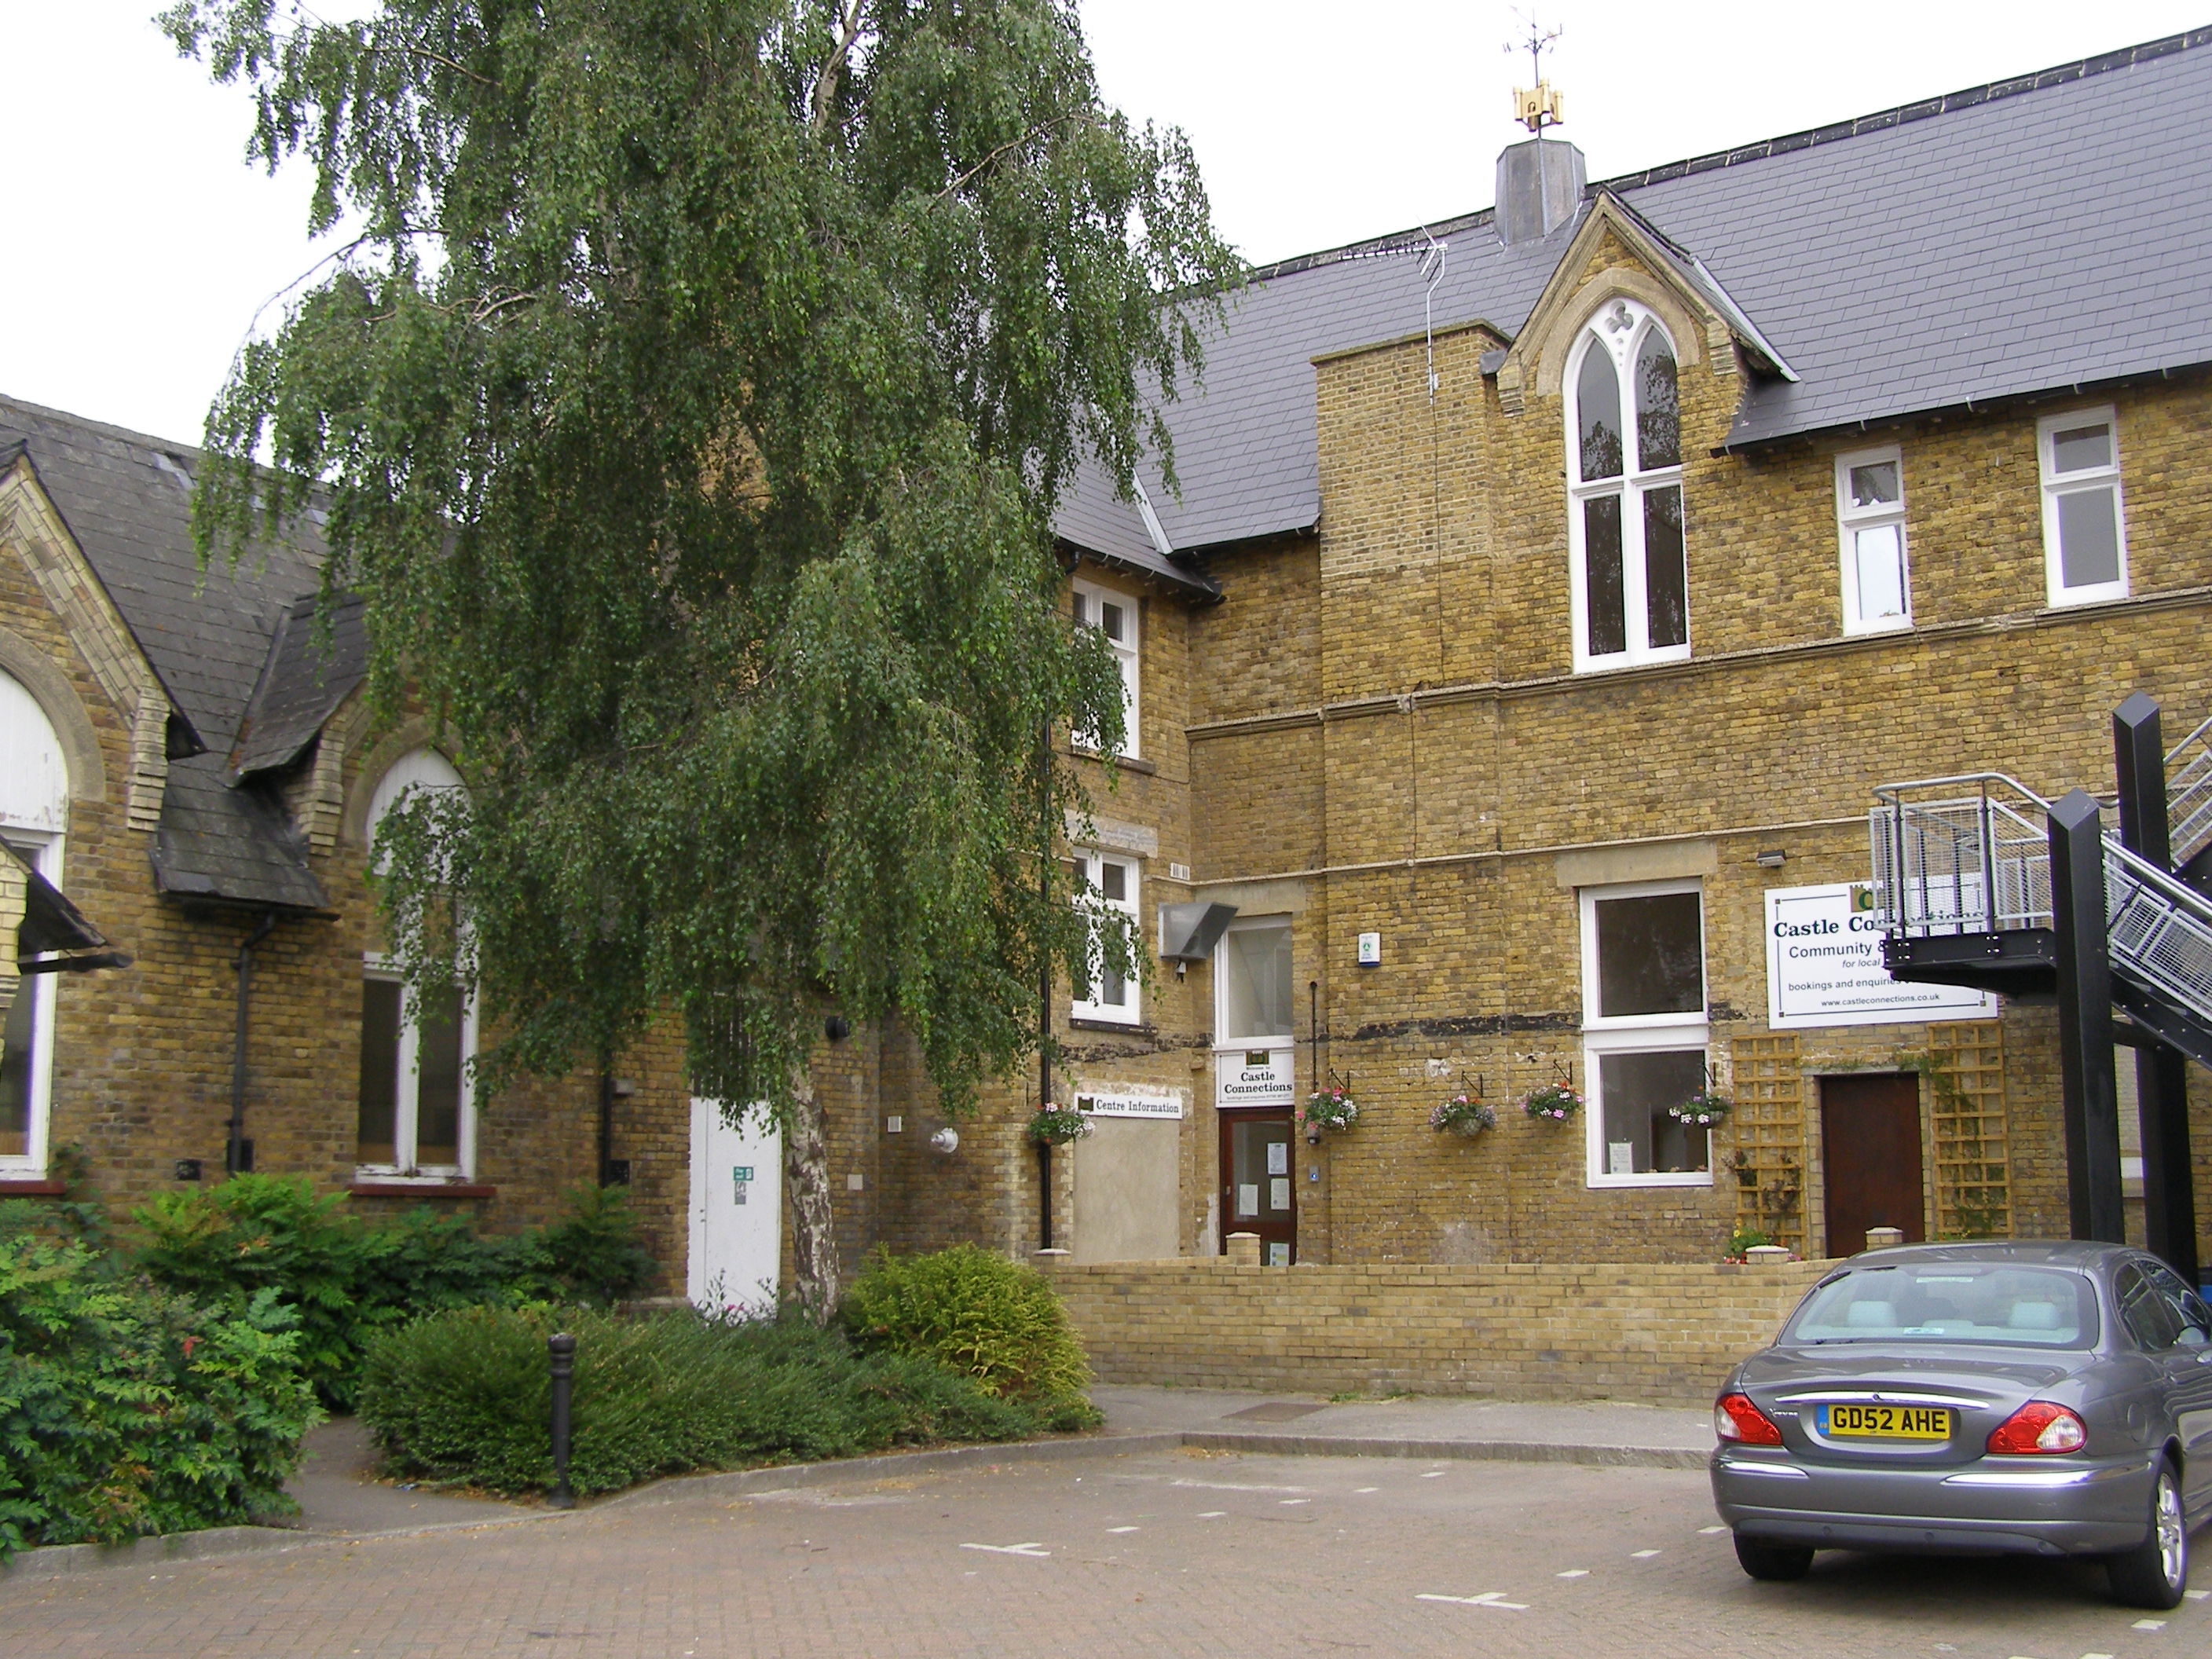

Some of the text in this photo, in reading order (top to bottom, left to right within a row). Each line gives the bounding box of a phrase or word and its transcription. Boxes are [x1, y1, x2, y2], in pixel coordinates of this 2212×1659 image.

[1774, 919, 1840, 938] Castle
[1789, 942, 1872, 958] Community
[1842, 958, 1881, 969] for local
[1788, 981, 1833, 991] bookings
[1835, 979, 1853, 988] and
[1821, 994, 1940, 1007] www.castleconnections.co.uk
[1240, 1071, 1276, 1082] Castle
[1224, 1082, 1293, 1094] Connections
[1096, 1099, 1180, 1113] Centre Information
[1833, 1407, 1946, 1433] GD52 AHE
